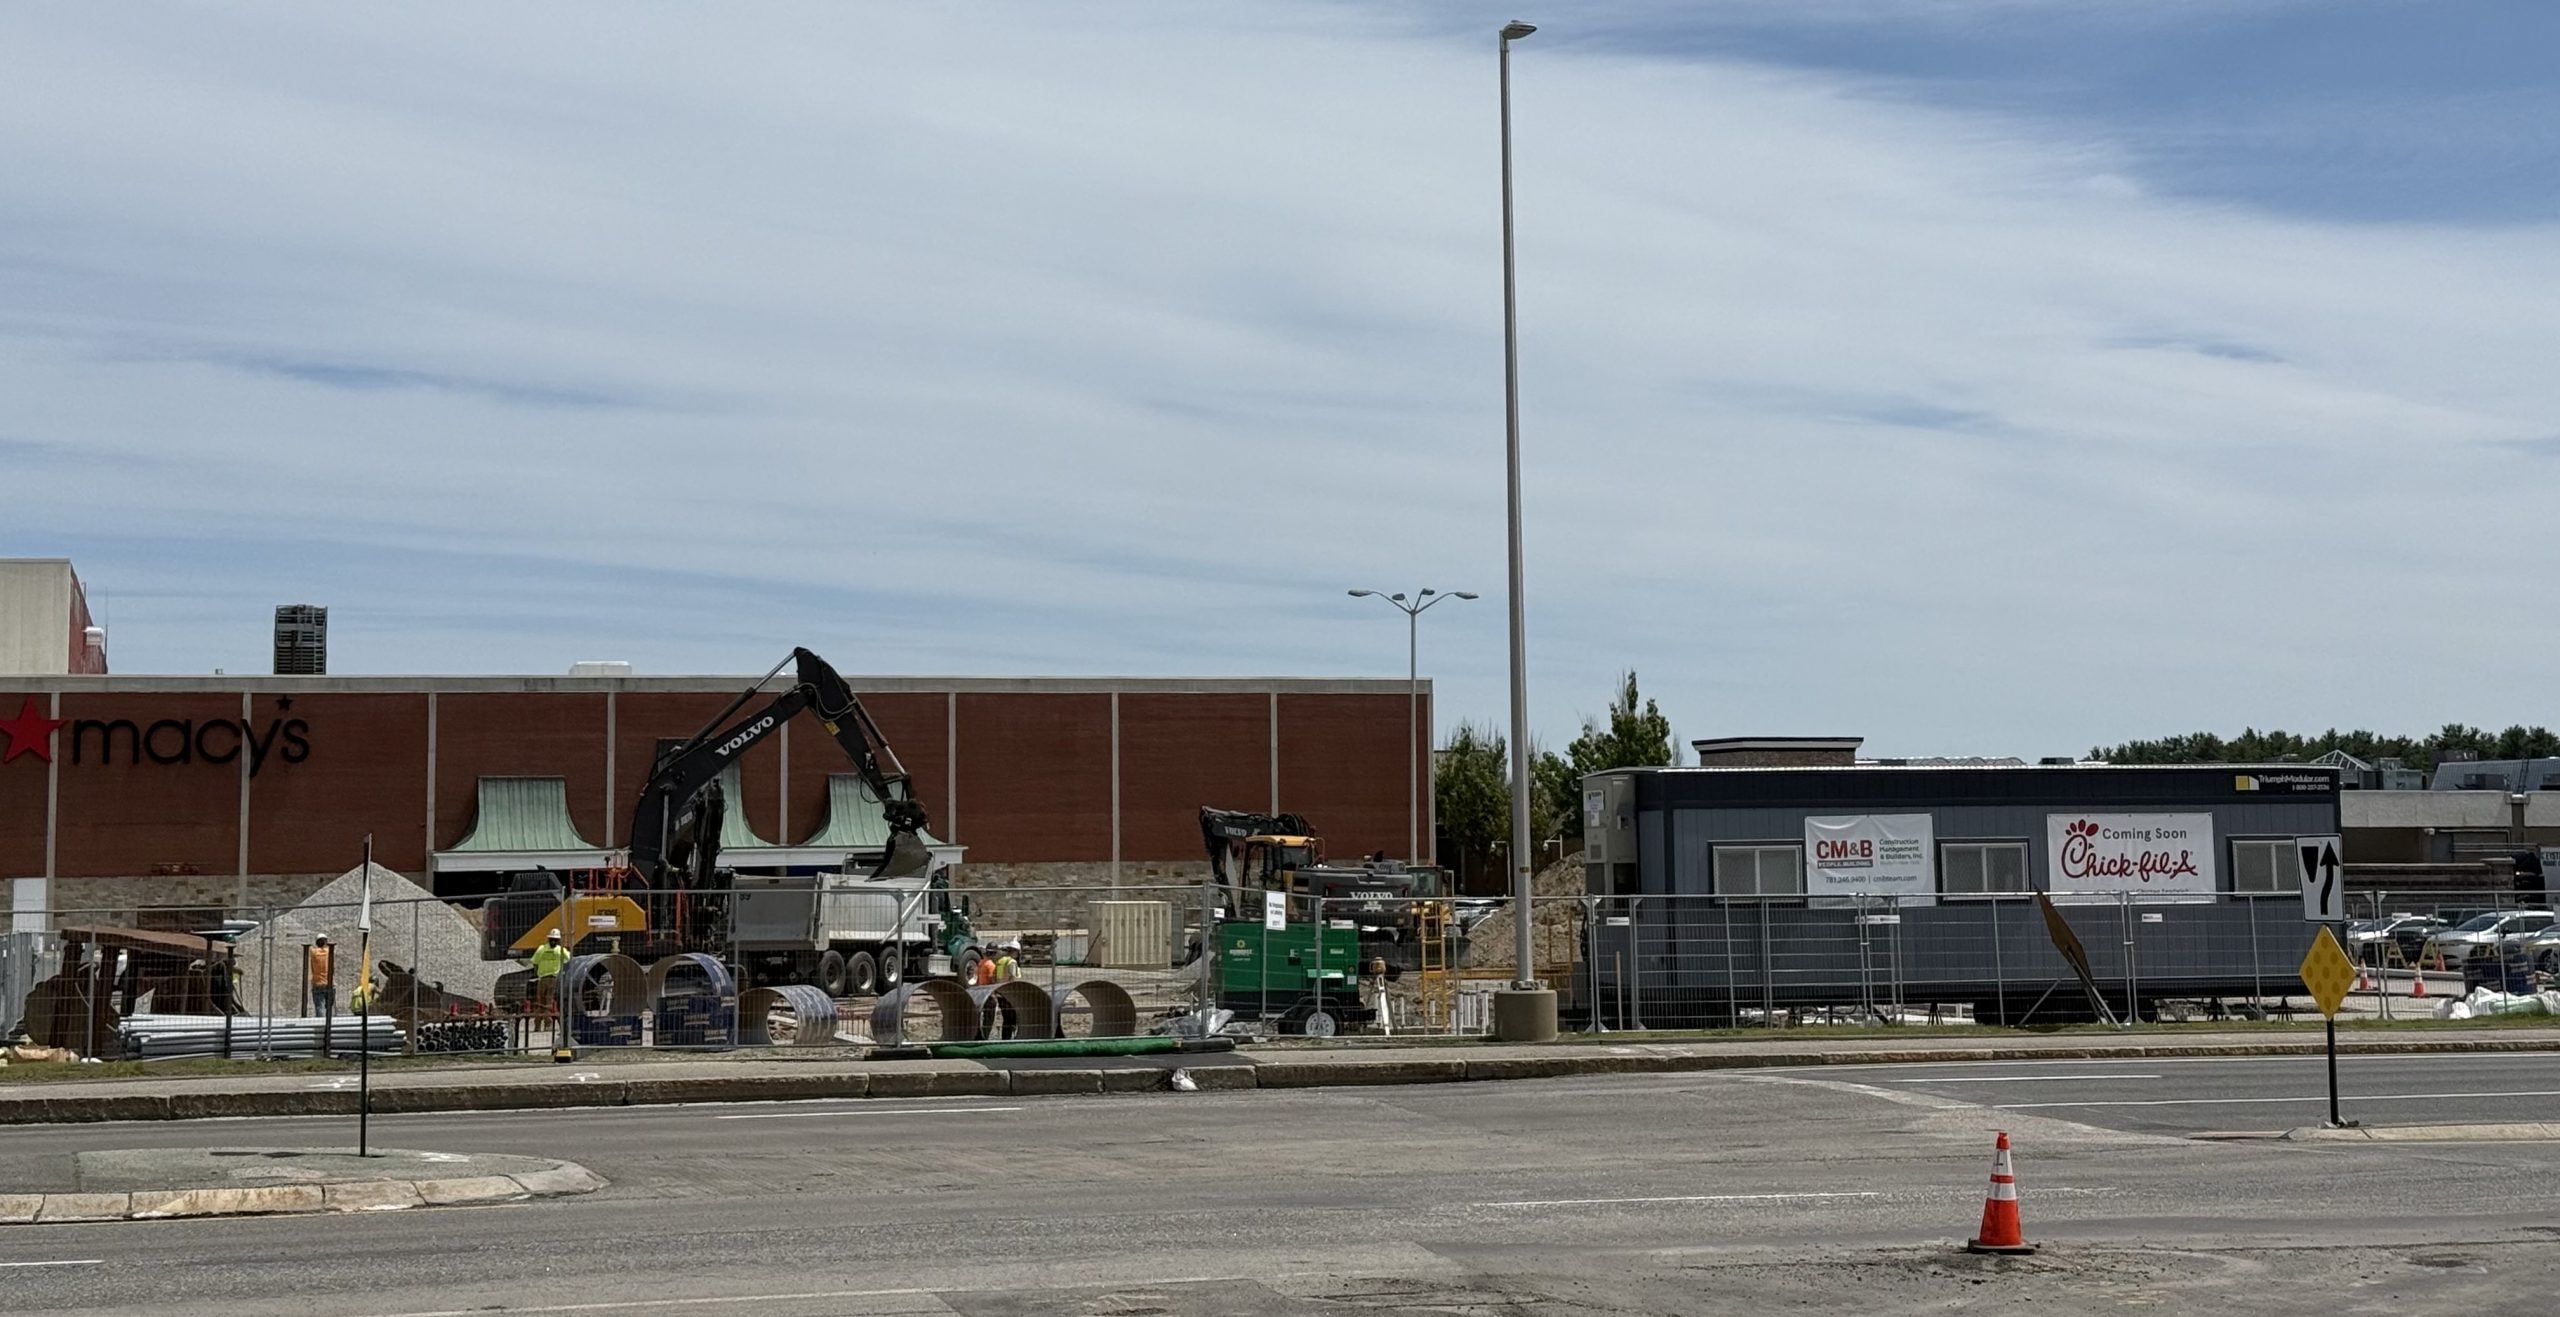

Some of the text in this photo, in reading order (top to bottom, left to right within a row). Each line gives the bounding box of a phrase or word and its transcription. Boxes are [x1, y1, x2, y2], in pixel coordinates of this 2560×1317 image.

[714, 716, 775, 756] VOLVO
[1879, 838, 1920, 846] Construction
[2102, 827, 2188, 842] Coming Soon
[1816, 839, 1873, 859] CM&B
[2061, 834, 2198, 882] Chick-fil-A
[1350, 891, 1394, 899] VOLVO
